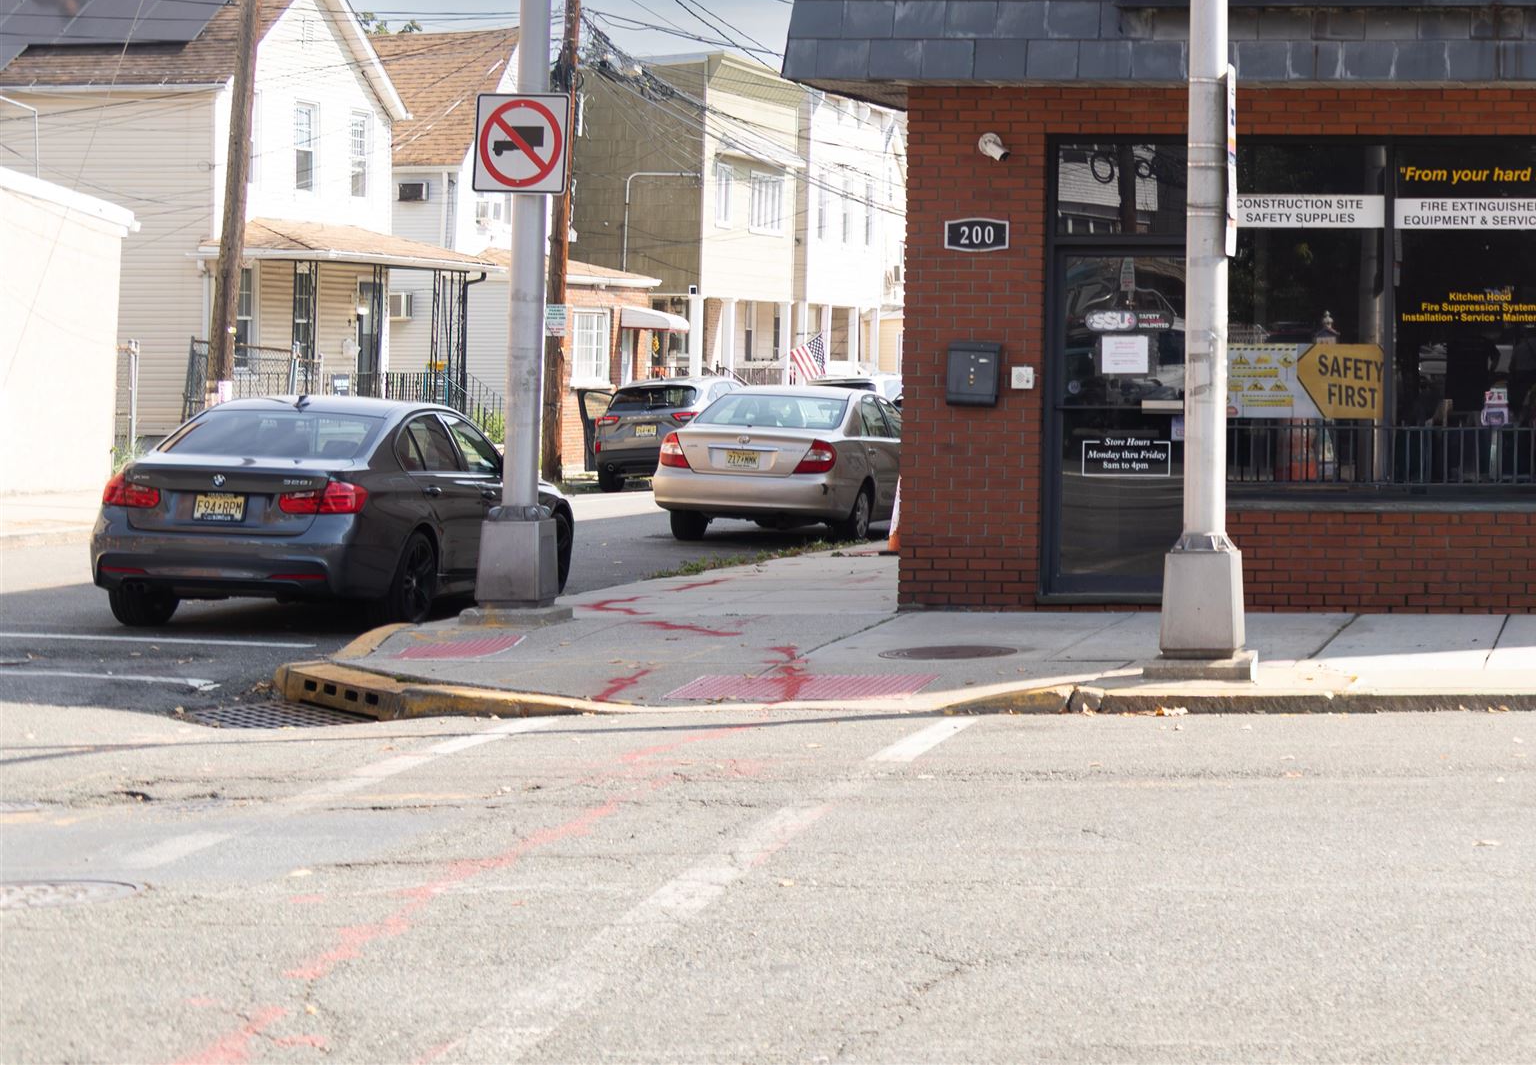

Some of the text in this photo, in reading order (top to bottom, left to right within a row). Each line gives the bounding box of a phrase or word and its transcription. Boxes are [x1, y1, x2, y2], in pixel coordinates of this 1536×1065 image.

[1400, 166, 1448, 182] "From
[1451, 169, 1490, 185] your
[1493, 167, 1532, 182] hard
[1236, 198, 1364, 210] CONSTRUCTION SITE
[1420, 201, 1448, 212] FIRE
[1246, 212, 1356, 223] SAFETY SUPPLIES
[1404, 215, 1476, 226] EQUIPMENT
[1480, 215, 1488, 226] &
[959, 225, 995, 245] 200
[1449, 292, 1512, 302] Kitchen Hood
[1421, 302, 1440, 312] Fire
[1441, 302, 1500, 313] Suppression
[1092, 311, 1131, 330] SSU
[1402, 313, 1453, 322] Installation
[1460, 313, 1495, 322] Service
[1317, 353, 1384, 383] SAFETY
[1327, 382, 1379, 409] FIRST
[1104, 437, 1151, 446] Store Hours
[1087, 450, 1167, 460] Monday thru Friday
[1102, 461, 1149, 471] 8am to 4pm
